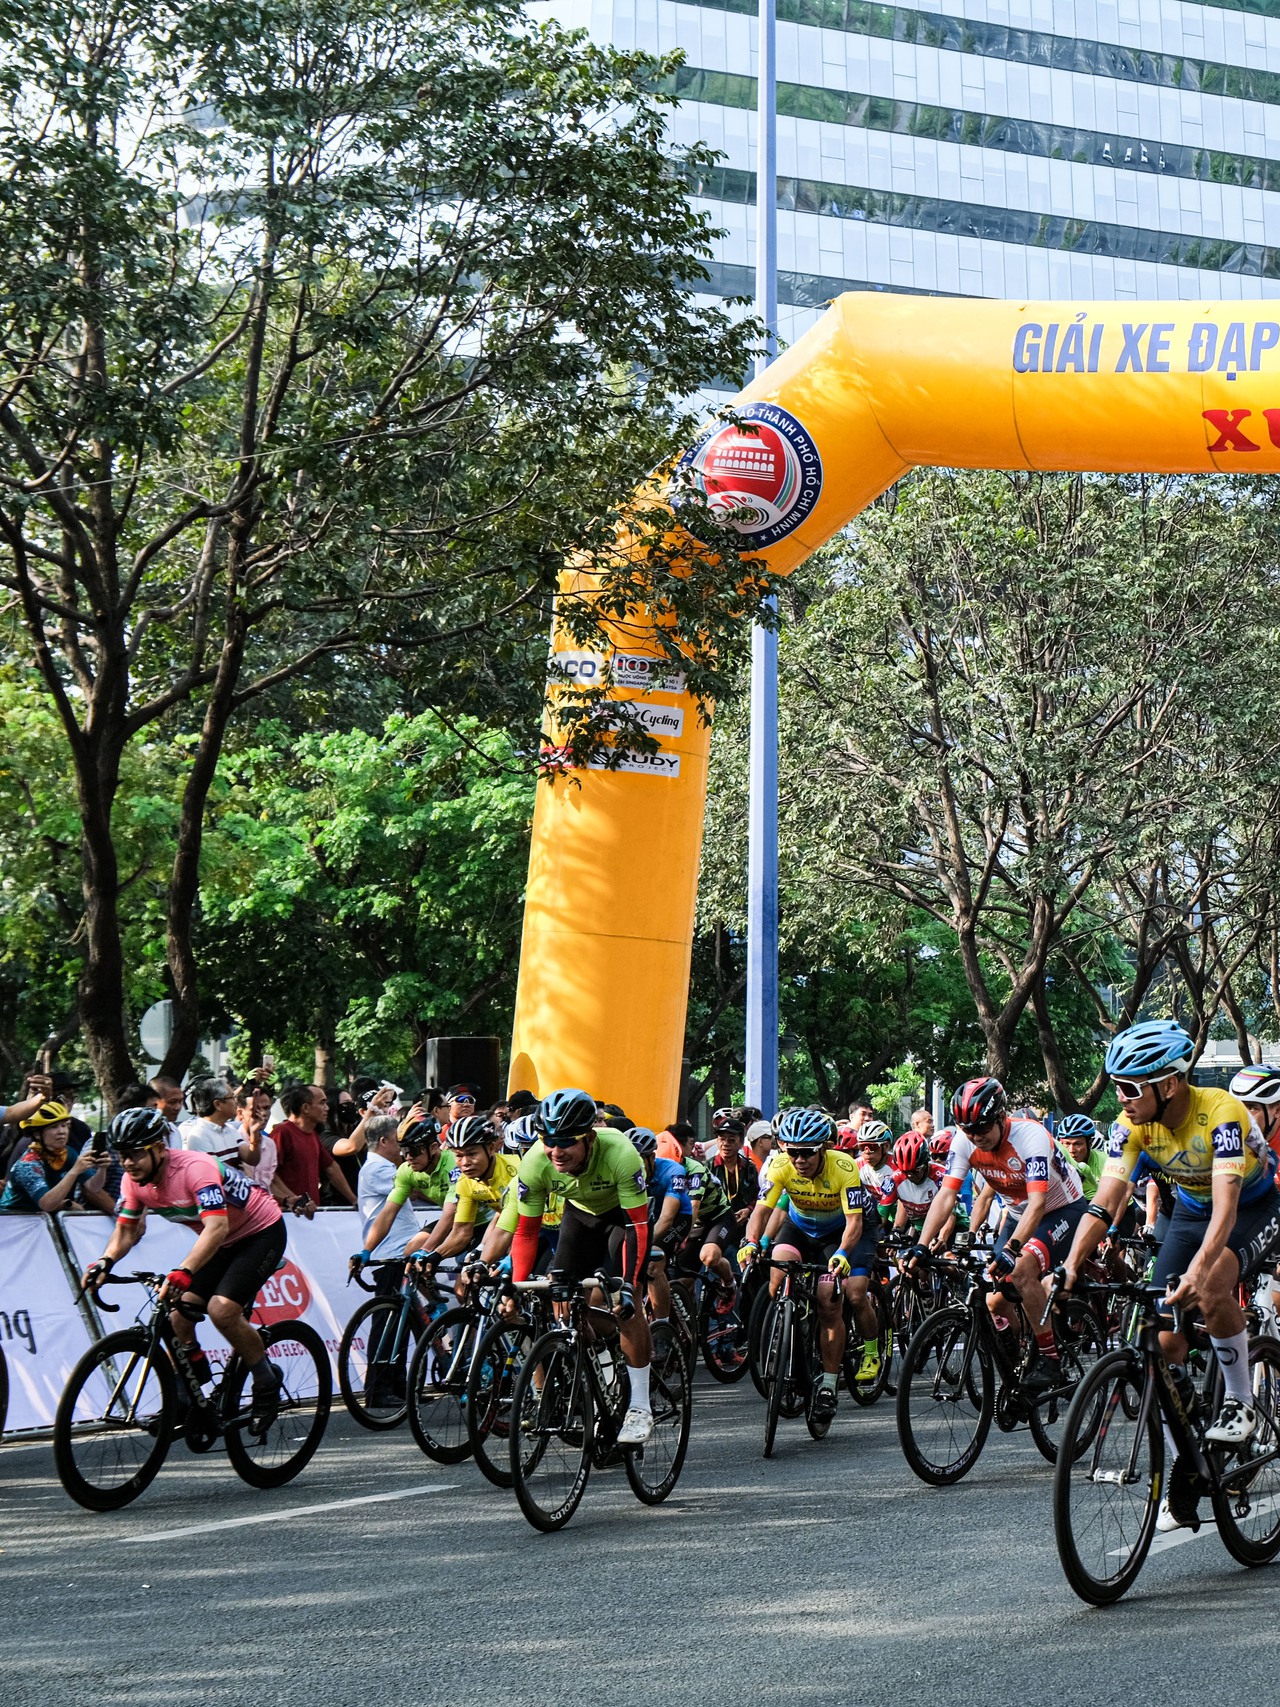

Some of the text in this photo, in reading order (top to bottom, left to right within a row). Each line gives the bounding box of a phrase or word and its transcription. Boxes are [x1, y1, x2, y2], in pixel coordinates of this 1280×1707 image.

[1012, 312, 1105, 374] GIẢI
[1119, 323, 1176, 374] XE
[1187, 321, 1280, 381] ĐẠP
[758, 408, 798, 437] THÀNH
[793, 434, 819, 463] PHỐ
[805, 467, 821, 486] HỒ
[800, 489, 815, 512] CHÍ
[770, 511, 802, 537] MINH
[640, 709, 680, 731] Cycling
[620, 763, 675, 773] PROJECT
[1215, 1128, 1241, 1152] 266
[1026, 1160, 1047, 1177] 223
[222, 1168, 251, 1201] 246
[200, 1188, 224, 1207] 246
